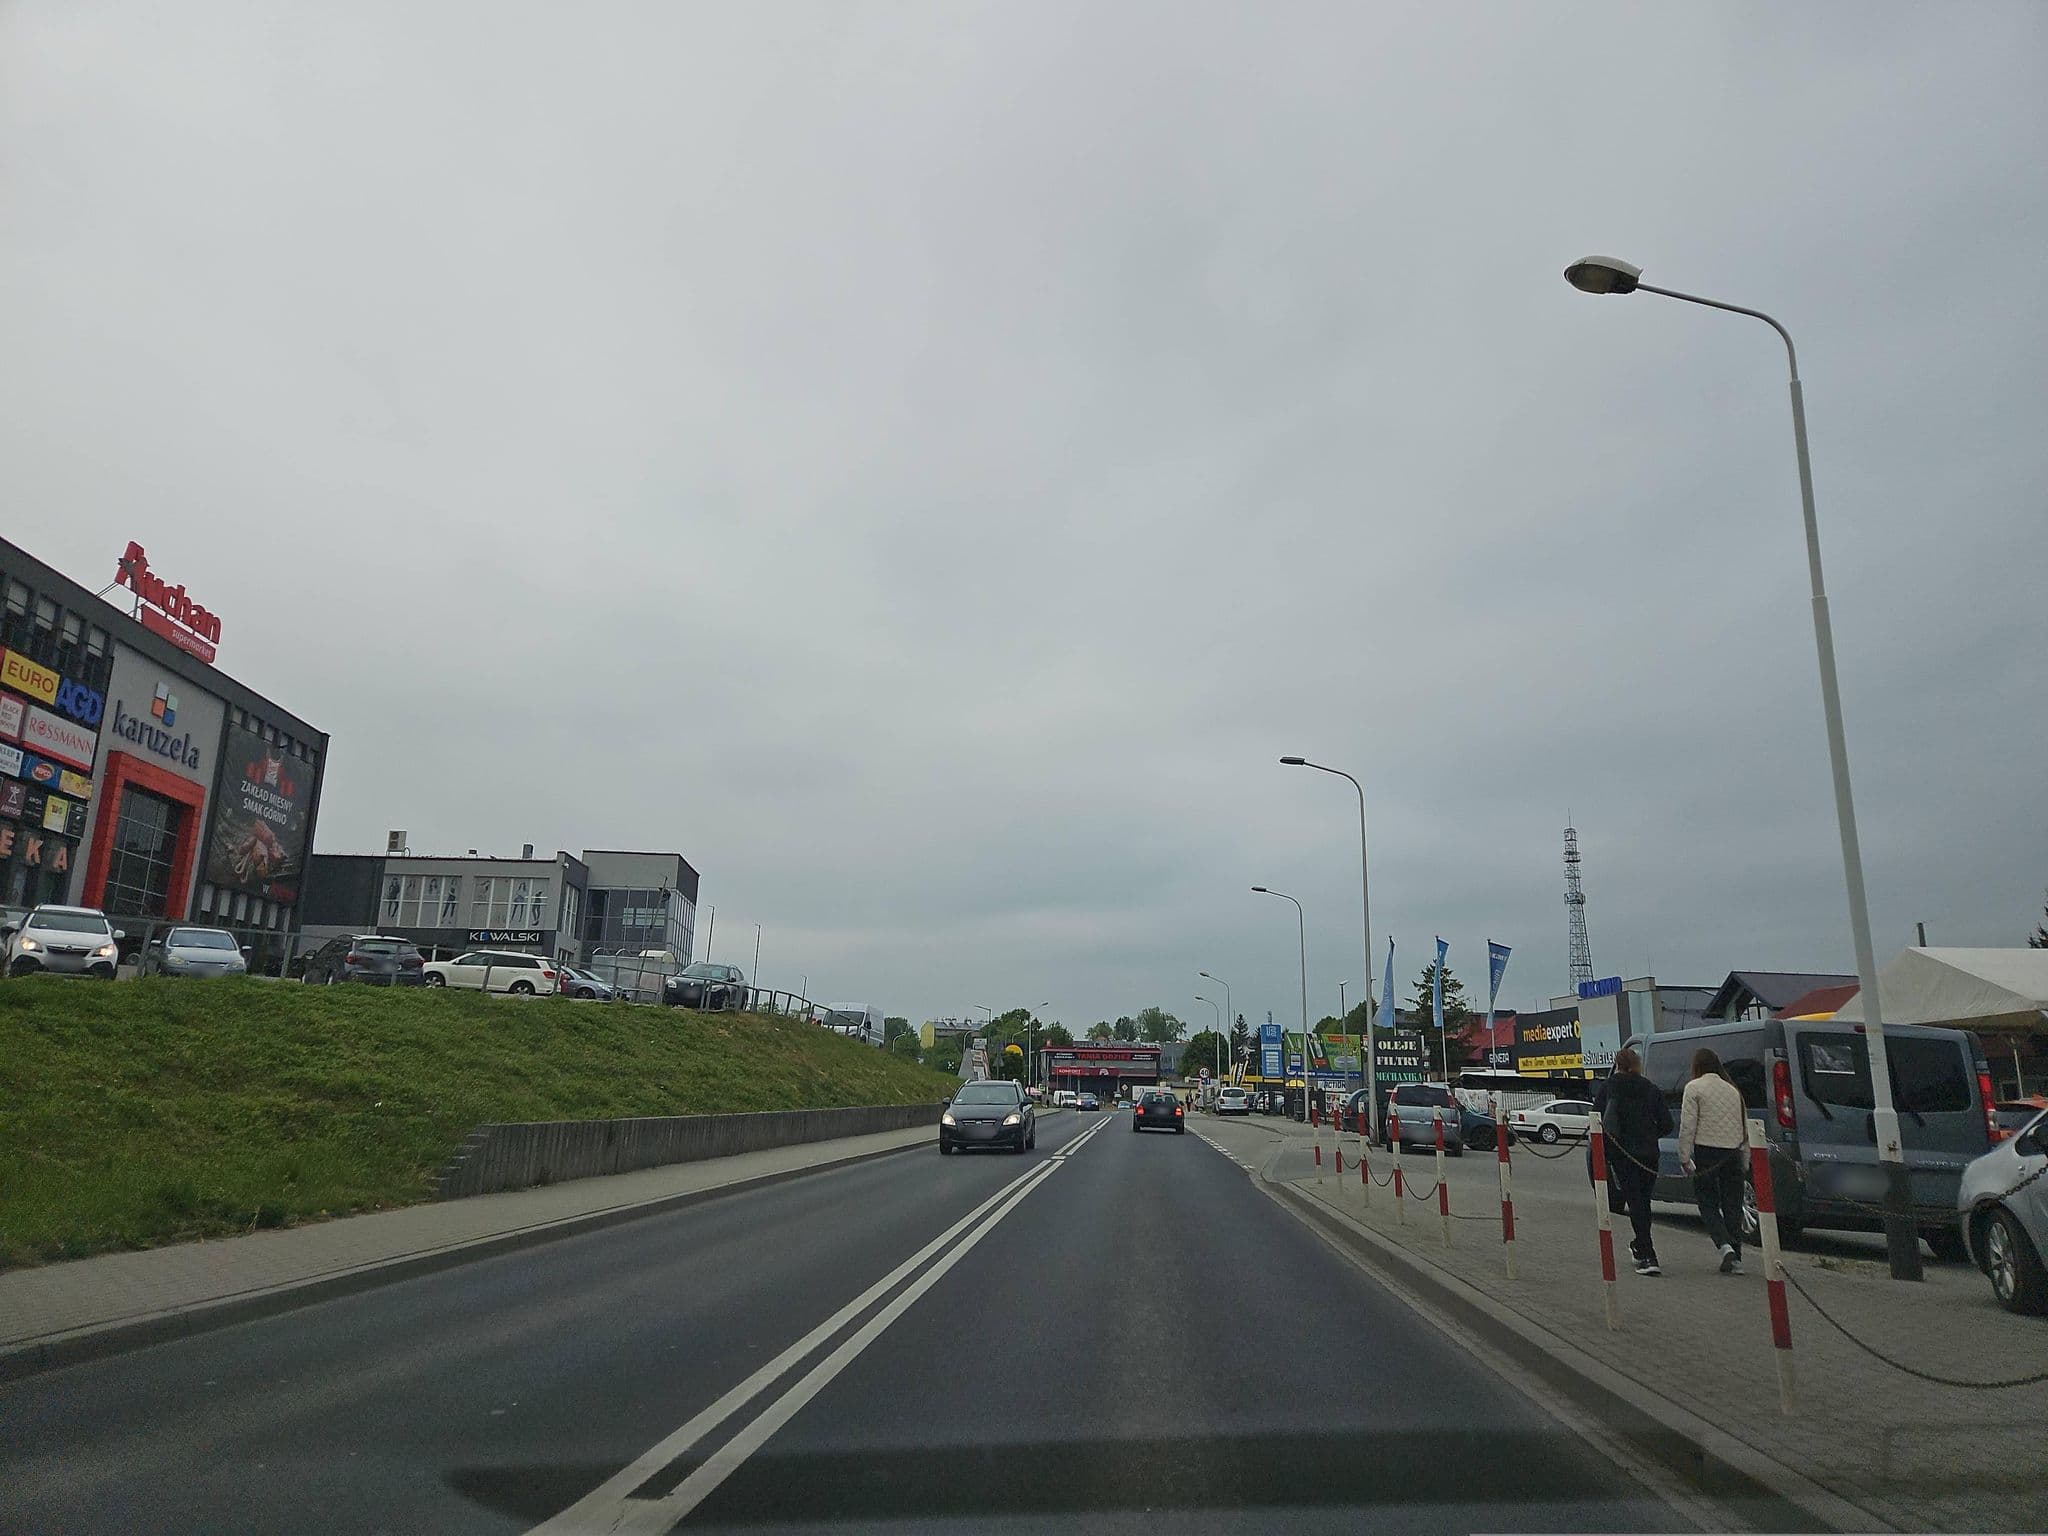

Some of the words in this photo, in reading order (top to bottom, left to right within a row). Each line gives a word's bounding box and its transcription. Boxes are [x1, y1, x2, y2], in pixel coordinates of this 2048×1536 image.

[114, 540, 220, 645] Auchan
[172, 629, 211, 659] supermarket
[7, 660, 54, 693] EURO
[55, 676, 105, 728] AGD
[29, 717, 93, 755] ROSSMANN
[112, 700, 200, 769] karuzela
[241, 780, 269, 802] ZAKŁAD
[243, 798, 263, 816] SMAK
[469, 932, 540, 942] KOWALSKI
[1377, 1040, 1417, 1051] OLEJE
[1376, 1055, 1419, 1066] FILTRY
[1200, 1069, 1209, 1077] 40
[1375, 1071, 1422, 1082] MECHANIKA
